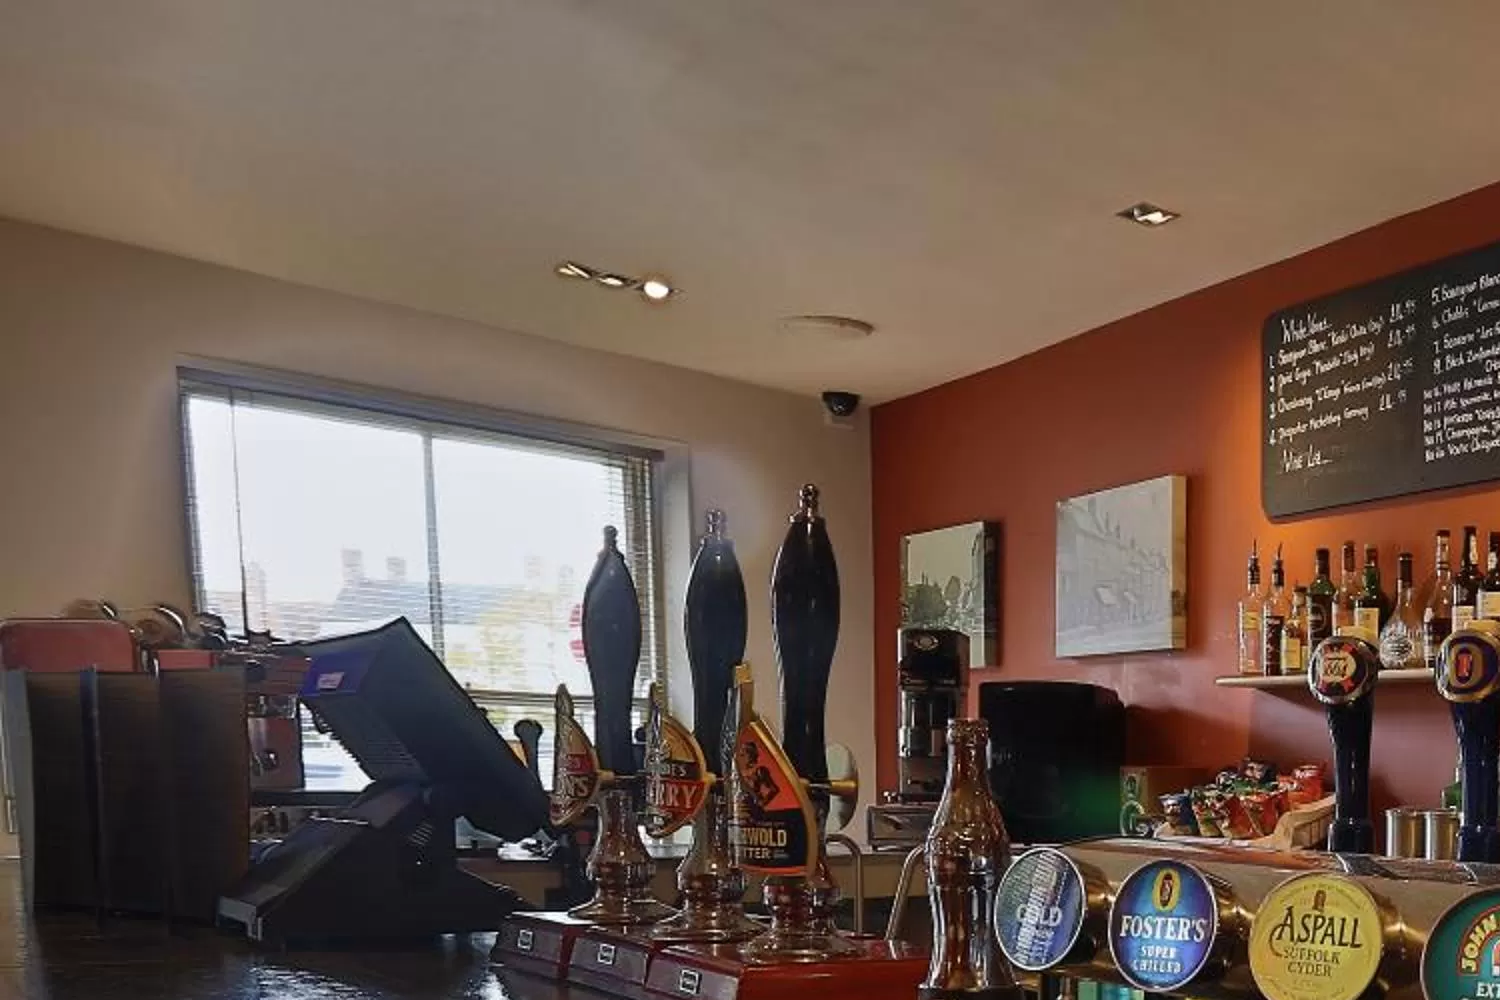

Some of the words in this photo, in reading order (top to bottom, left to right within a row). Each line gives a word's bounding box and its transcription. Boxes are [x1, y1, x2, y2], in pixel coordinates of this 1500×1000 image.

[1119, 914, 1208, 943] FOSTER'S
[1269, 905, 1364, 951] ASPALL
[1140, 944, 1177, 959] SUPER
[1461, 912, 1498, 973] JOHN
[1283, 946, 1342, 965] SUFFOLK
[1286, 961, 1333, 978] CYDER
